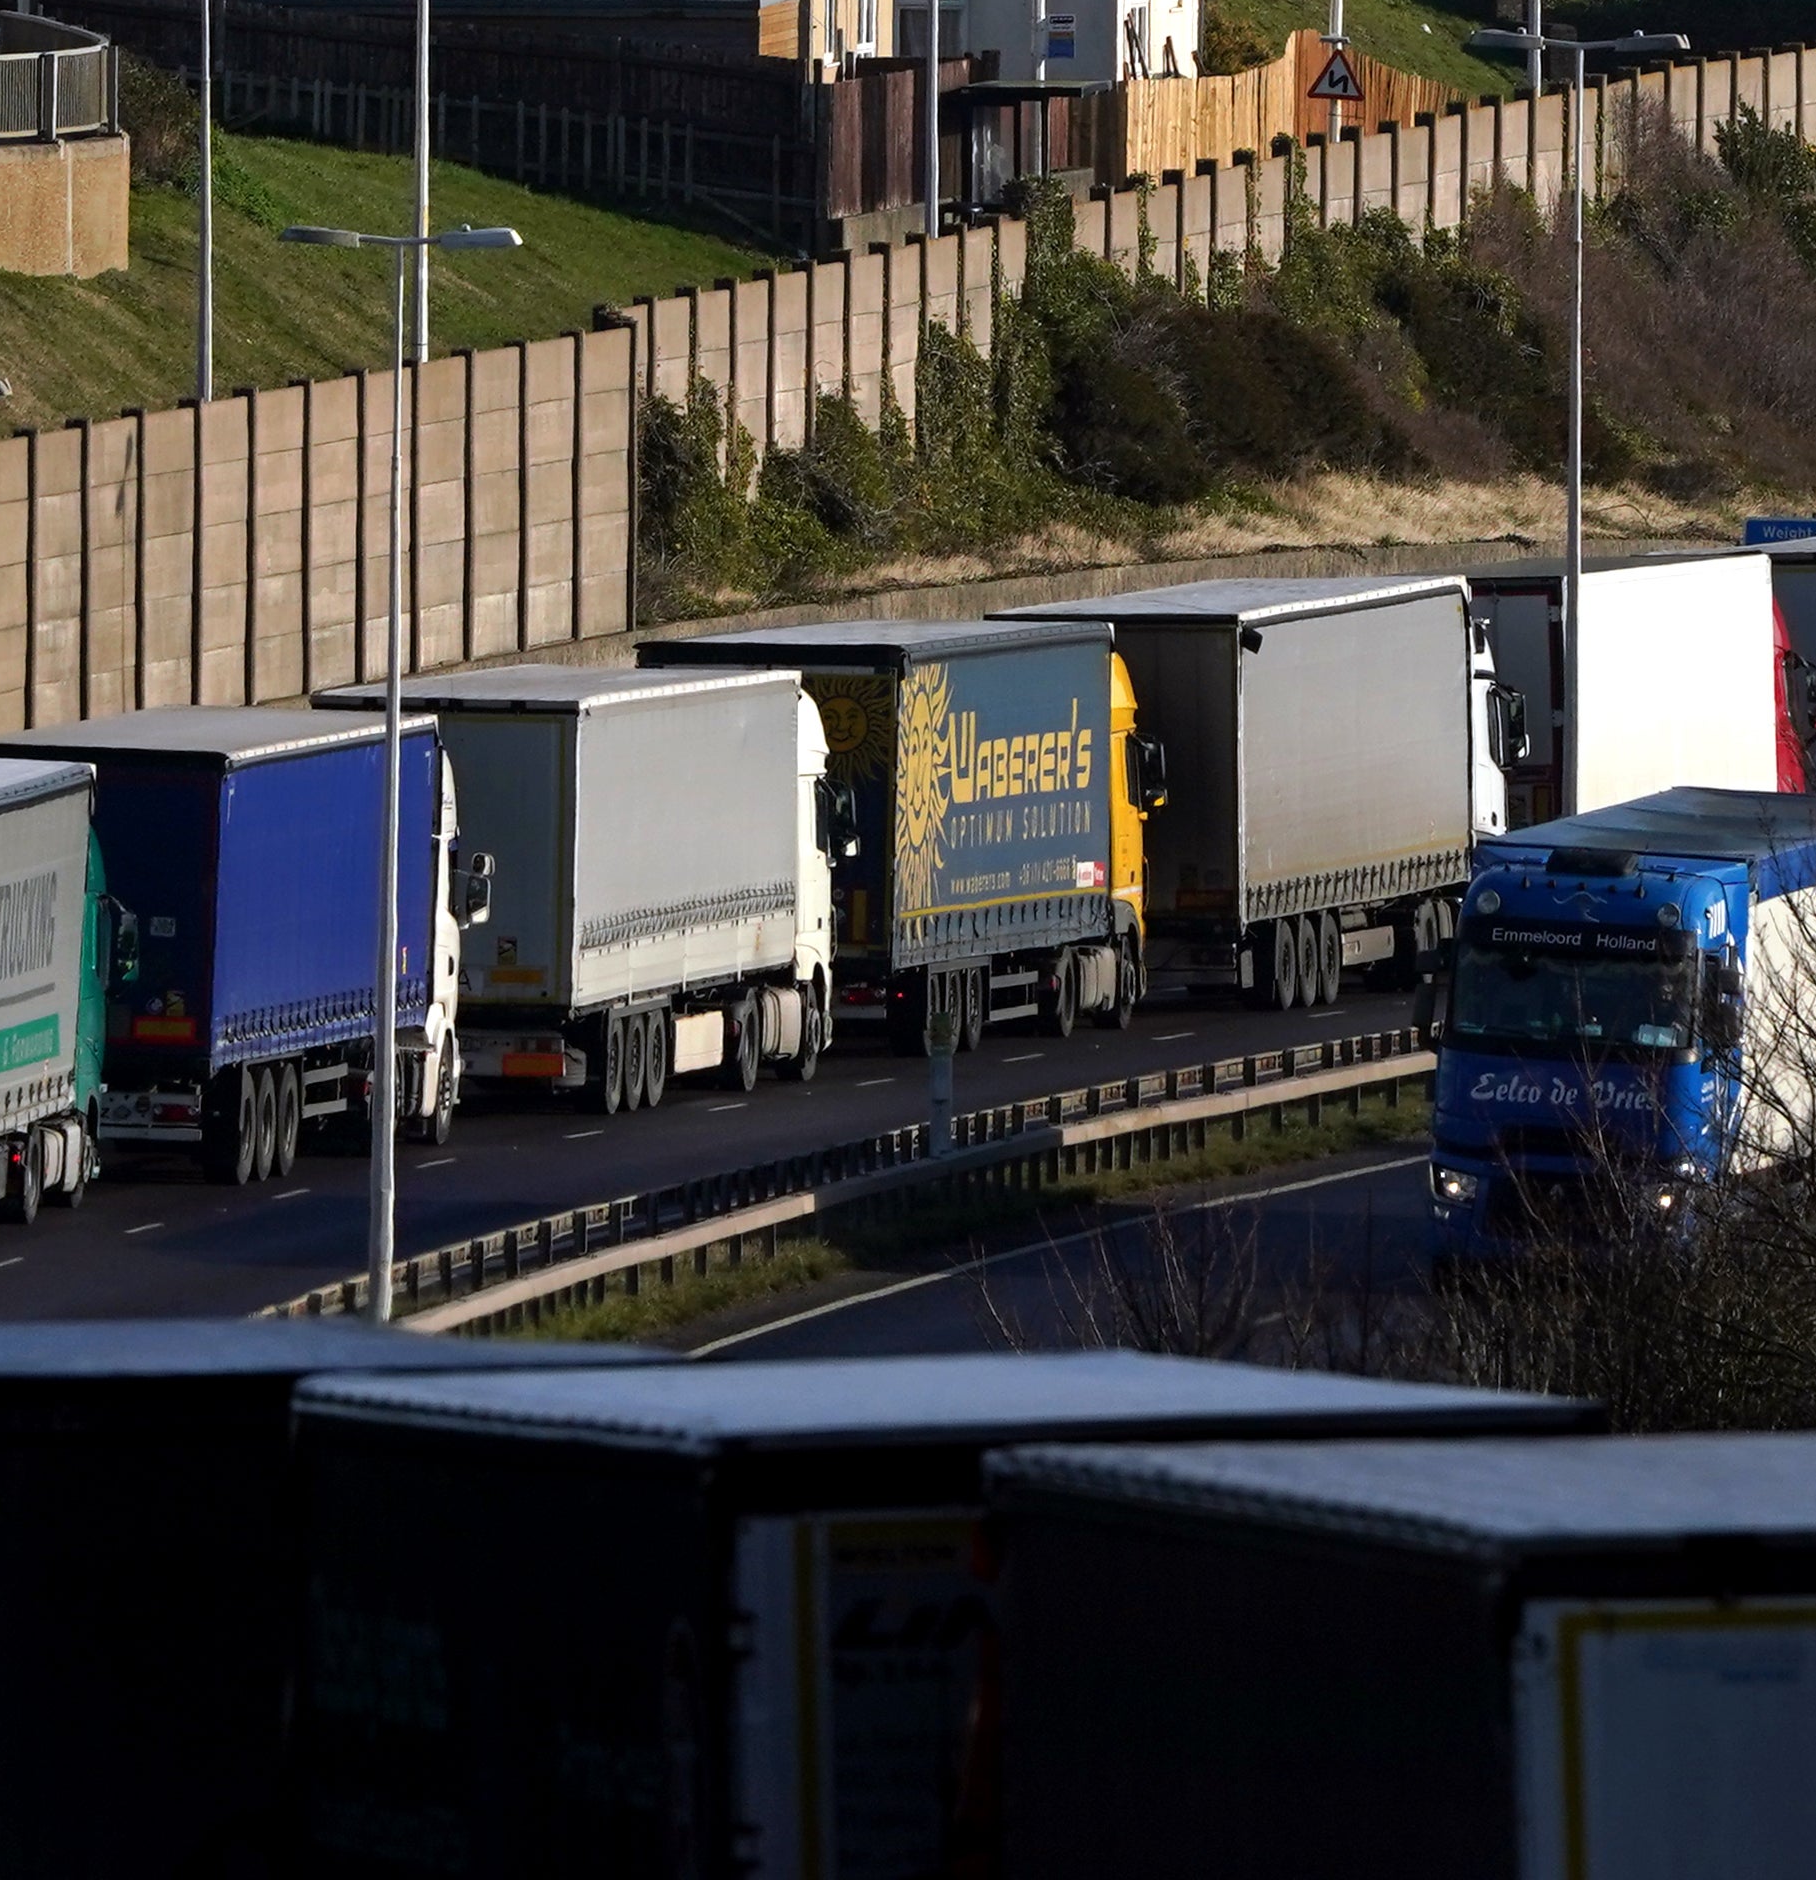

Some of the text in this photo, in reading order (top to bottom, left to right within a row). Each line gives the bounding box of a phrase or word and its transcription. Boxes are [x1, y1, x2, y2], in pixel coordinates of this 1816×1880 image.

[1762, 525, 1813, 539] Weight
[948, 697, 1092, 804] WABERER'S
[951, 800, 1091, 849] OPTIMUM SOLUTION
[1492, 928, 1657, 951] Emmeloord Holland
[1470, 1073, 1542, 1104] Eelco
[1550, 1077, 1578, 1105] de
